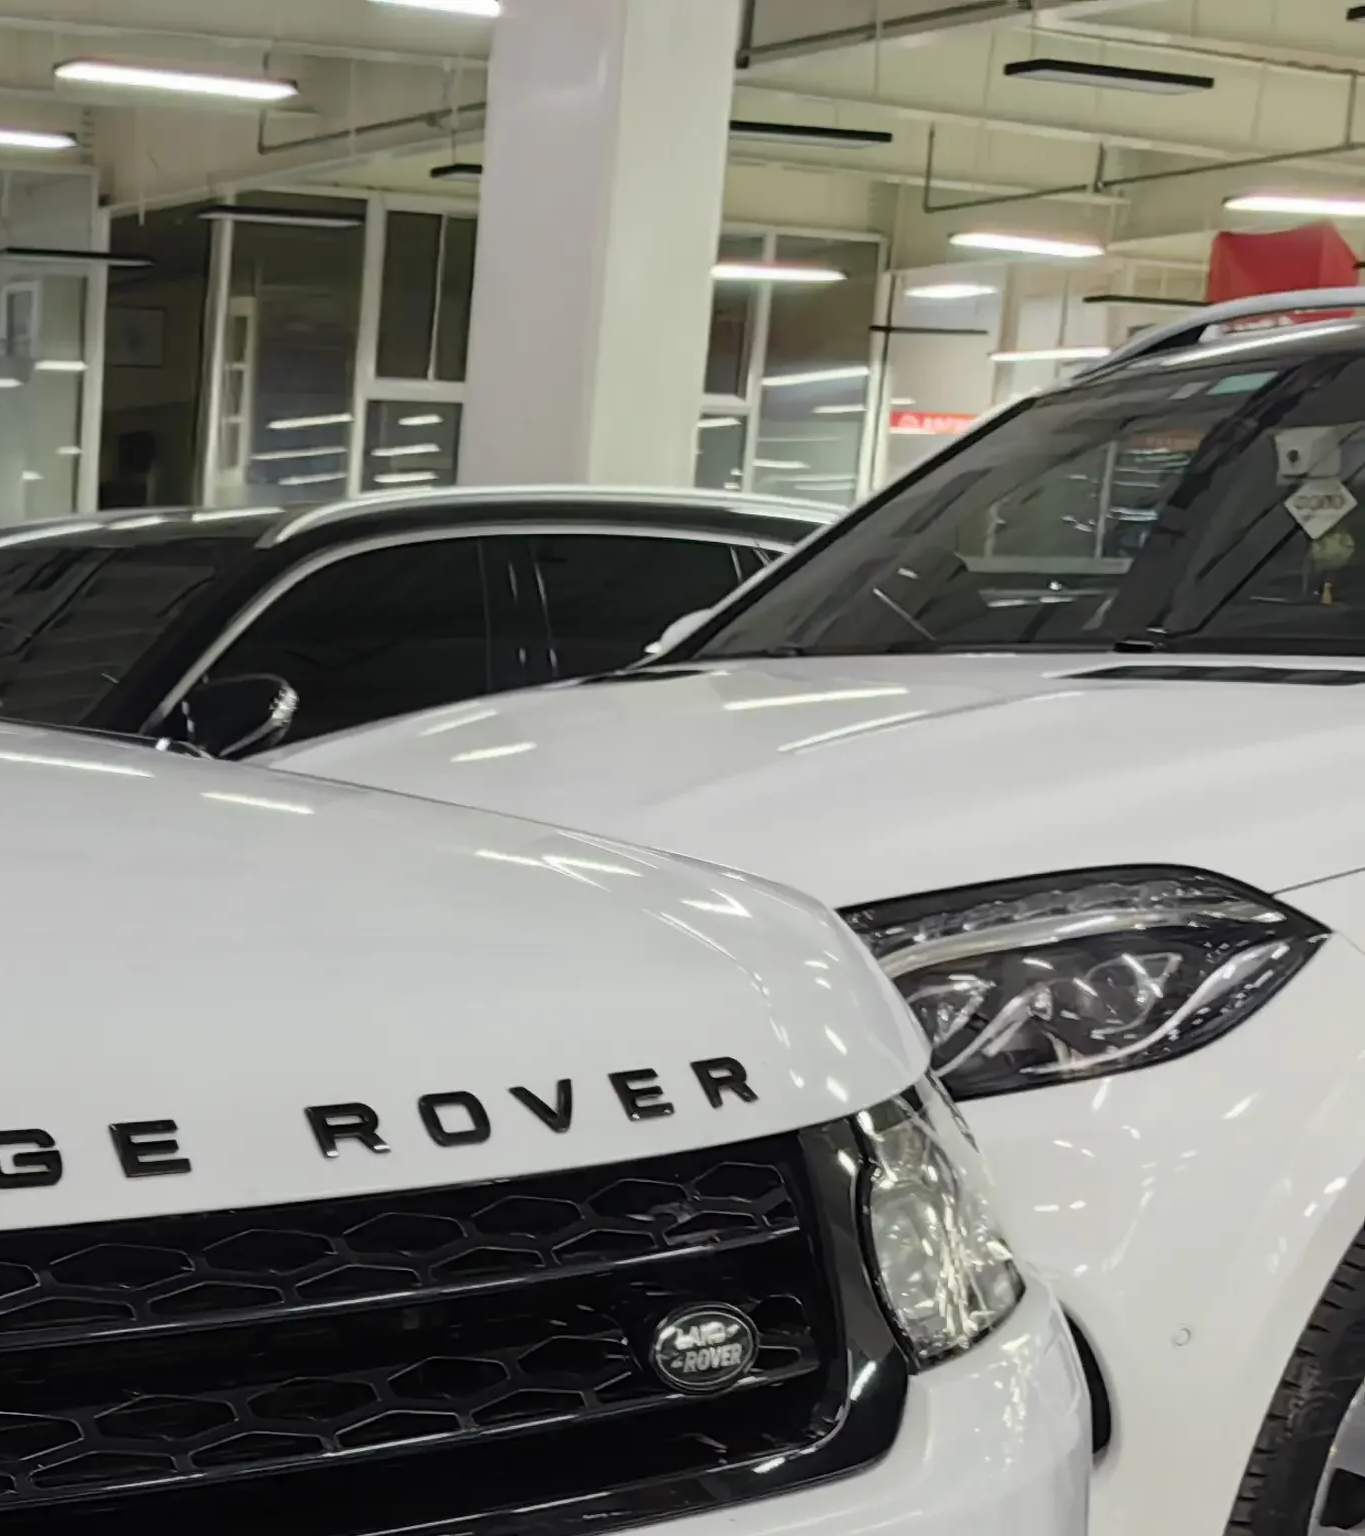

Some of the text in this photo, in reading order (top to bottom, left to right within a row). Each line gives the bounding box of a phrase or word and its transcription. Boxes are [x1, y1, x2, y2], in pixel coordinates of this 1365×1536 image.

[303, 1055, 761, 1159] ROVER
[674, 1321, 726, 1350] LAND
[683, 1343, 743, 1372] ROVER
